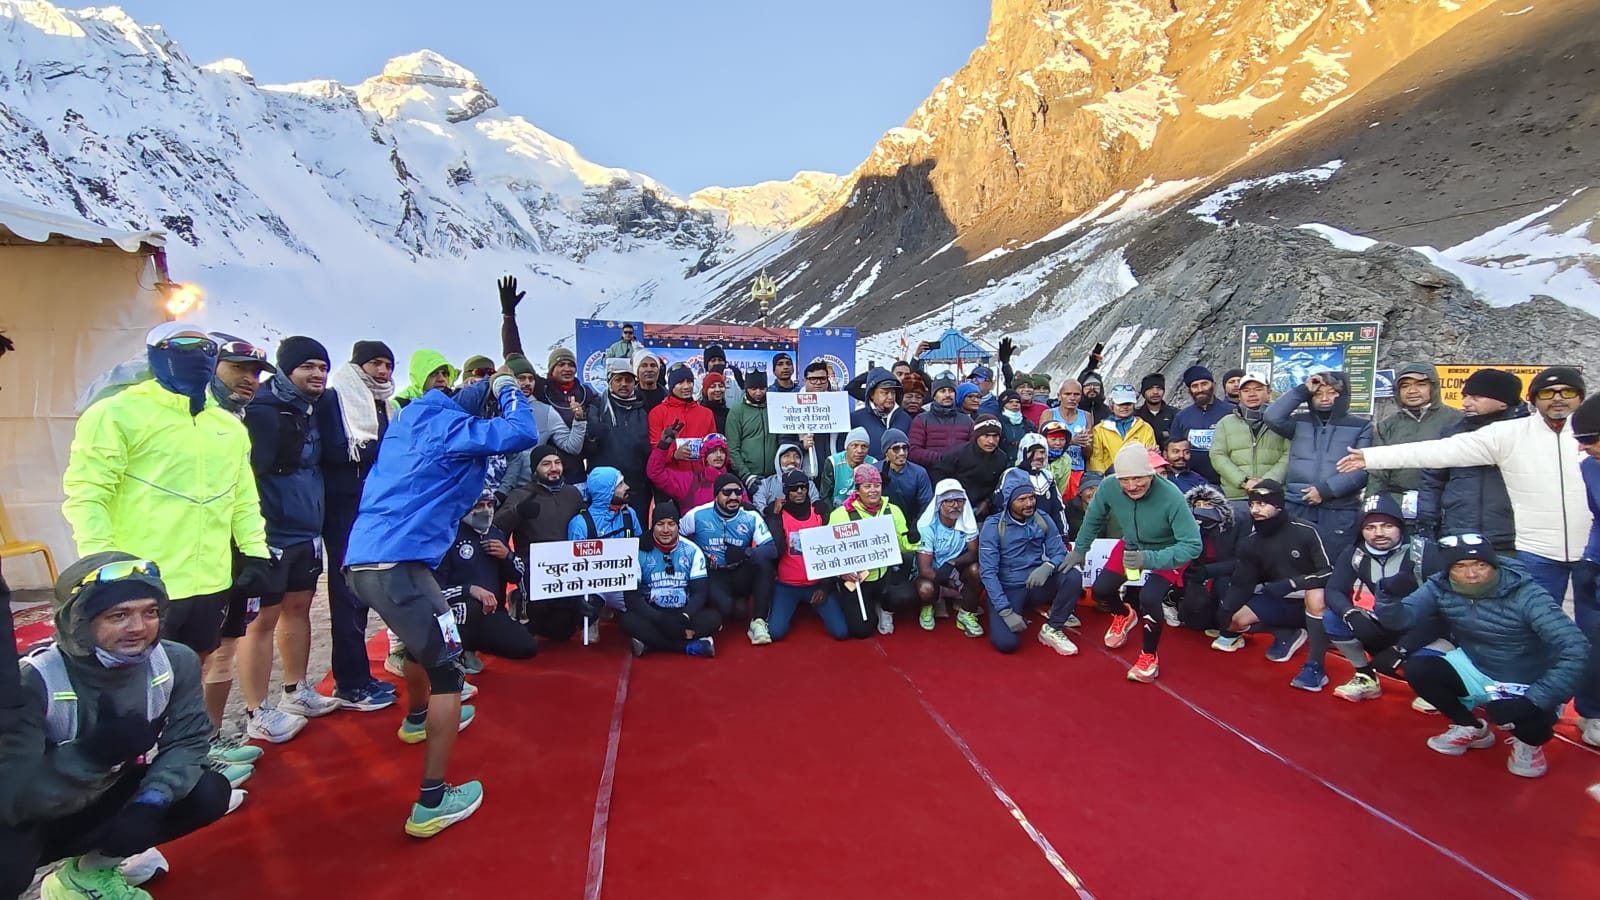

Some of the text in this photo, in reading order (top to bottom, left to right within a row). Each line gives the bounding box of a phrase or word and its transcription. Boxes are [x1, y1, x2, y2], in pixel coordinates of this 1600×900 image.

[1266, 331, 1354, 343] ADI KAILASH
[1444, 391, 1457, 400] ARE
[812, 405, 831, 413] जियो
[802, 414, 810, 422] से
[812, 414, 830, 422] जियो
[1193, 435, 1211, 443] 7005
[575, 541, 597, 549] सजग
[838, 541, 847, 552] से
[849, 539, 868, 550] नाता
[870, 533, 890, 548] जोड़ो
[537, 555, 633, 577] “खुद को जगाओ
[811, 560, 827, 572] नशे
[829, 557, 841, 569] की
[843, 554, 866, 566] आदत
[542, 573, 634, 593] नशे को भगाओ”
[660, 595, 680, 603] 7320
